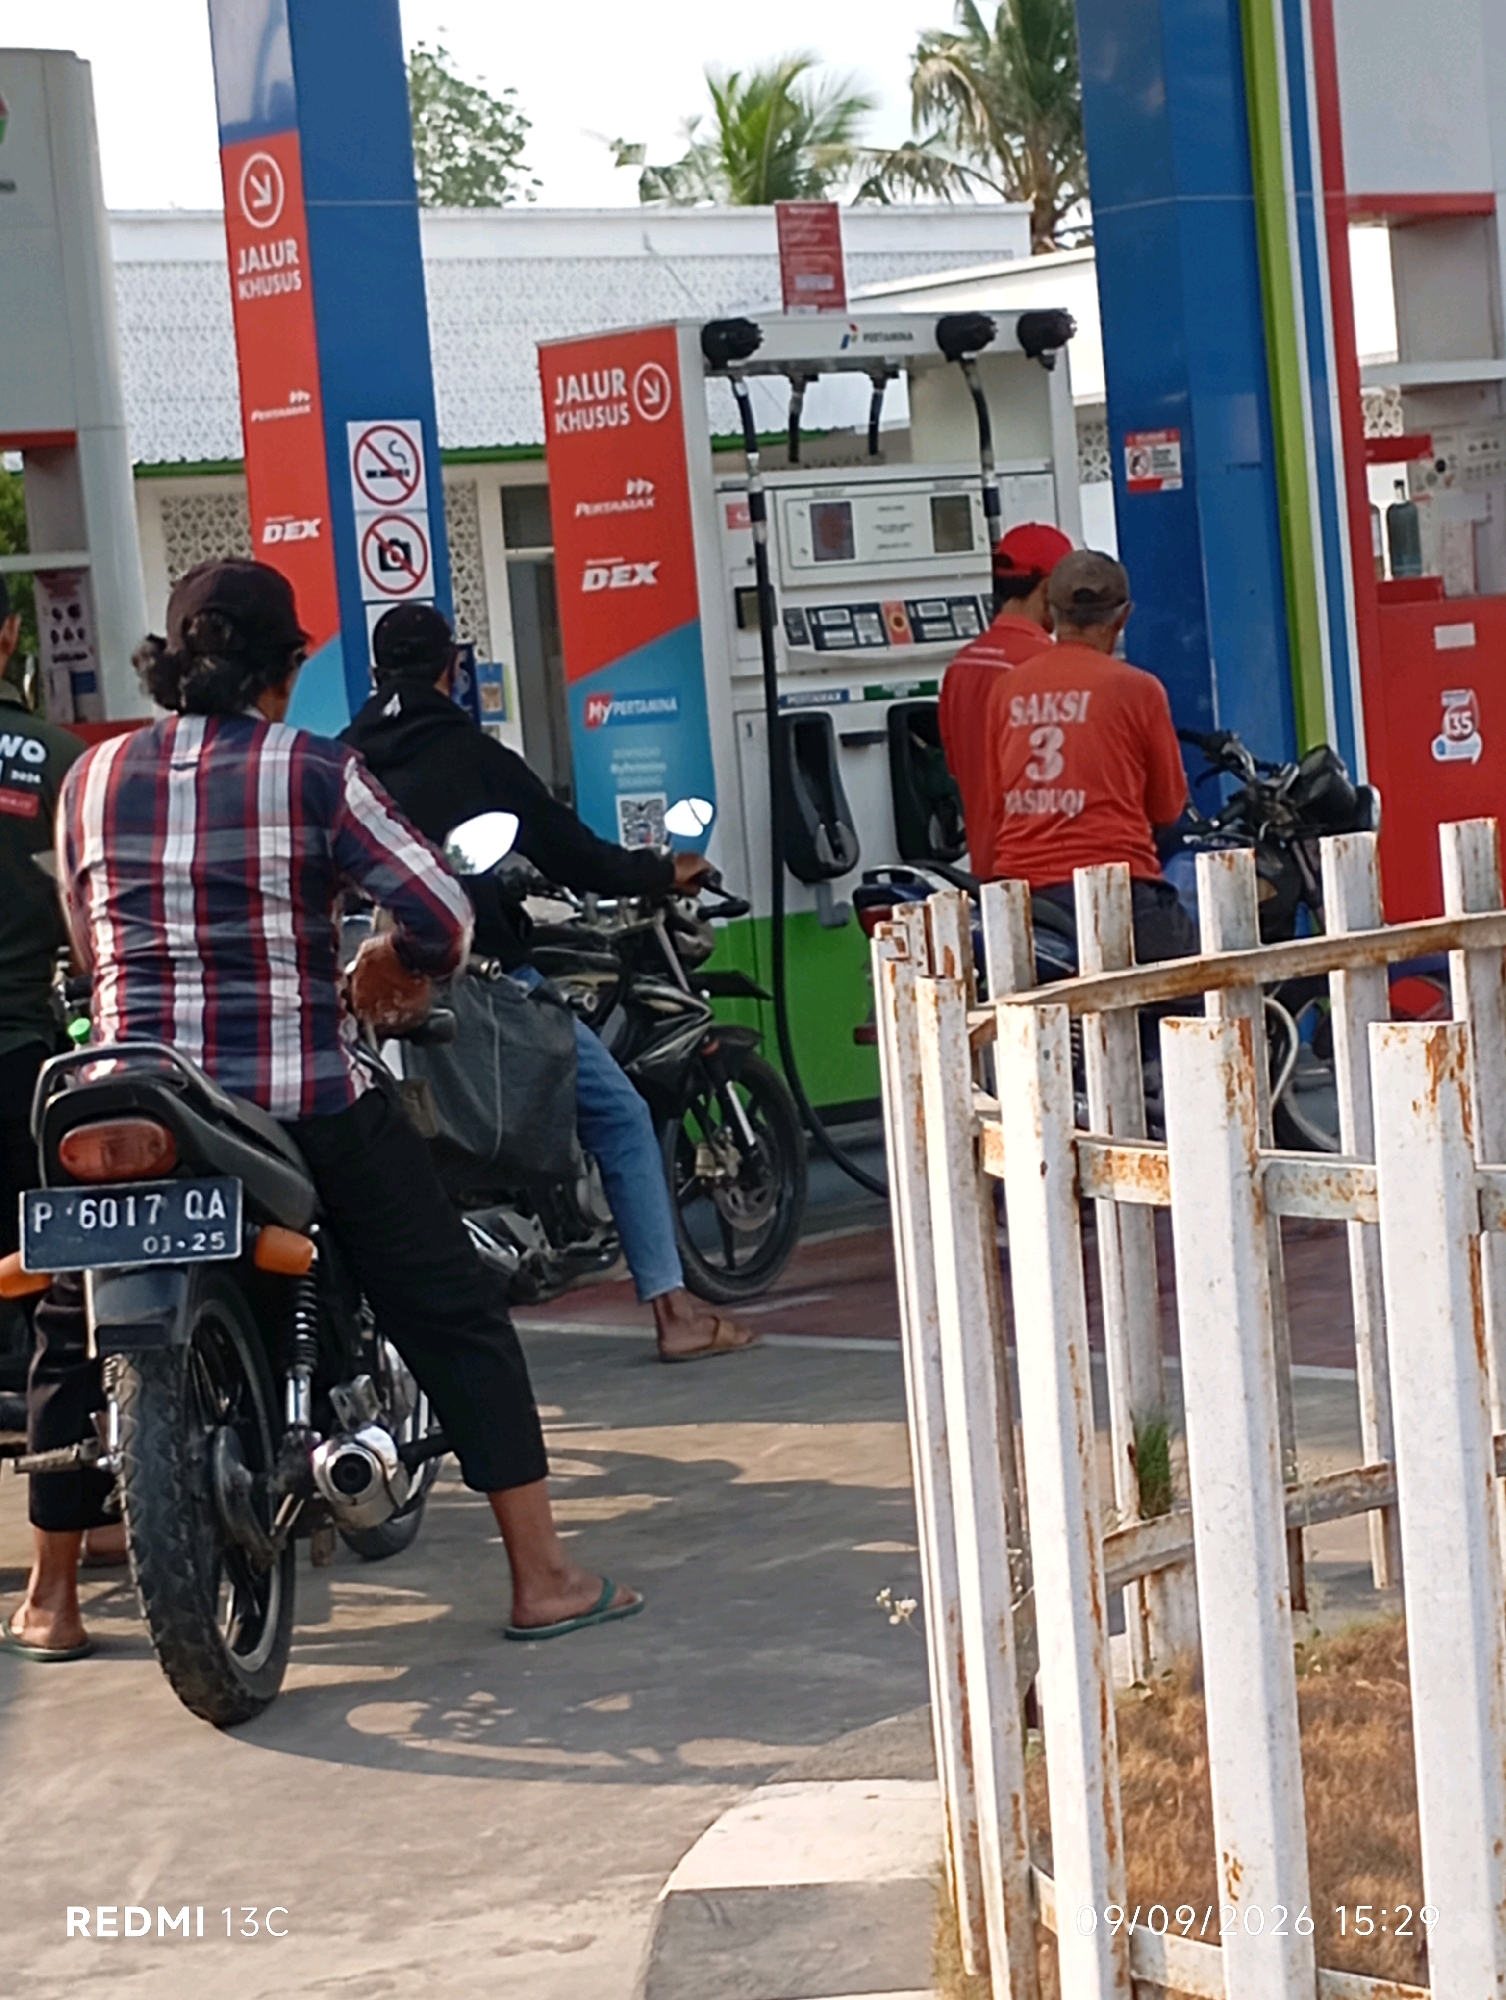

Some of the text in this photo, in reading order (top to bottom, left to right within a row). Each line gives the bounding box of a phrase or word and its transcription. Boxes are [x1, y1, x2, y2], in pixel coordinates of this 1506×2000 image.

[238, 238, 299, 275] JALUR
[238, 269, 302, 300] KHUSUS
[554, 367, 627, 405] JALUR
[555, 402, 630, 433] KHUSUS
[262, 518, 322, 544] DEX
[582, 560, 660, 592] DEX
[1009, 689, 1092, 728] SAKSI
[1025, 725, 1065, 782] 3
[33, 1188, 227, 1233] P 6017 QA
